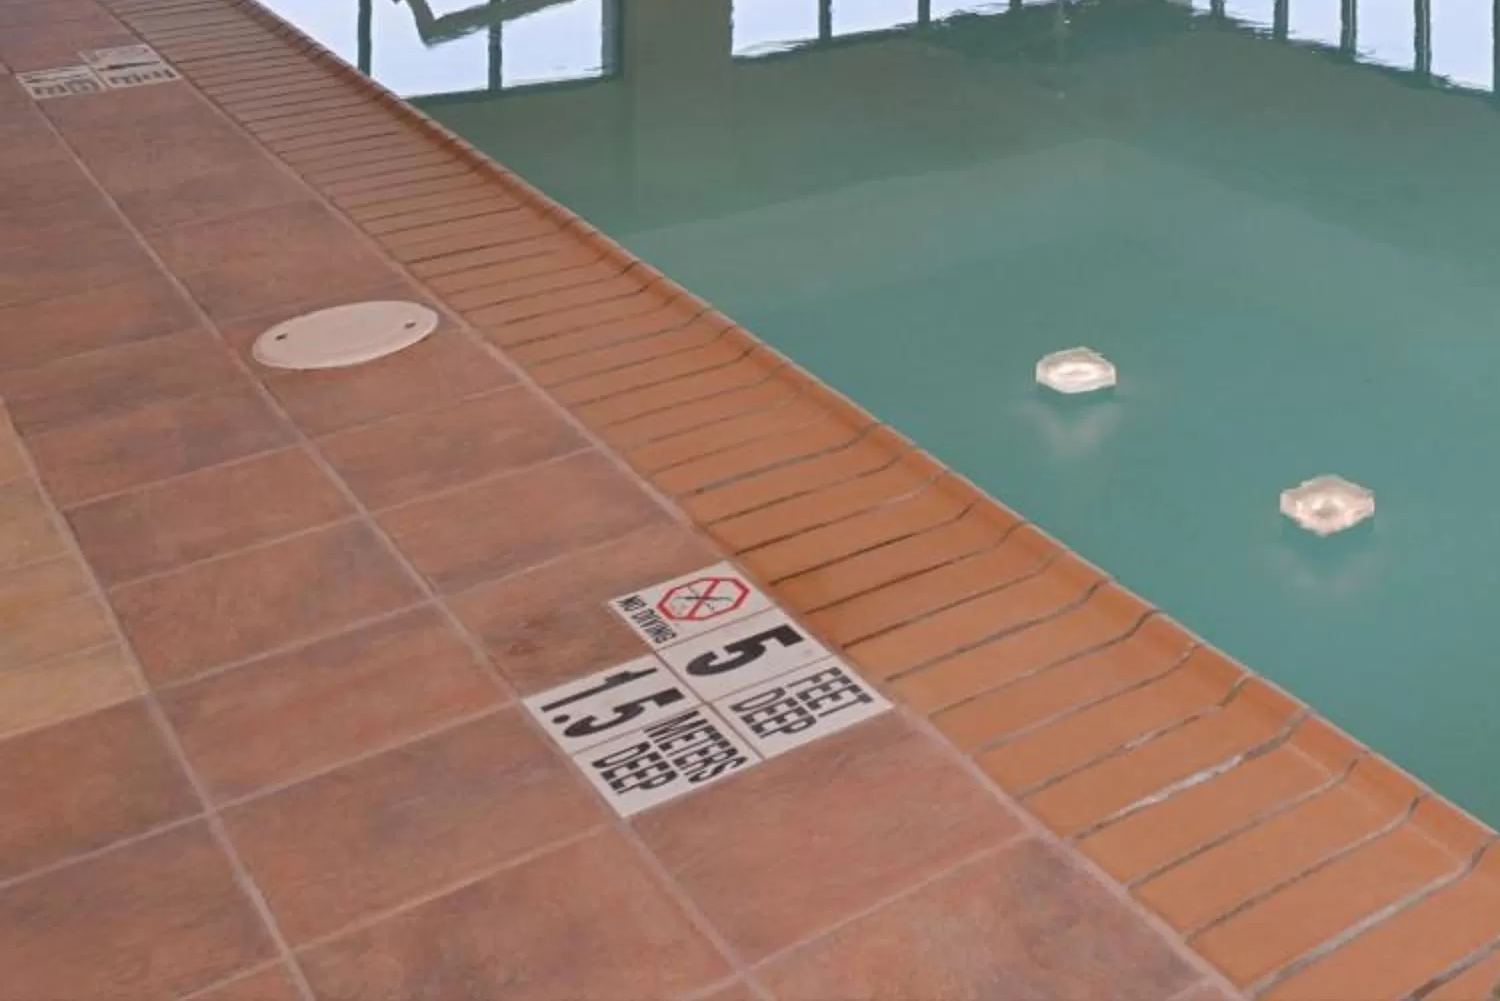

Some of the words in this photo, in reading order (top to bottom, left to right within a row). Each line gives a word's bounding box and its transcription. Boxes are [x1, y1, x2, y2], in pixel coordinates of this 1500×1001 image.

[686, 624, 805, 676] 5
[541, 667, 685, 738] 1.5
[728, 686, 818, 739] DEEP
[788, 666, 874, 717] FEET
[592, 740, 680, 795] DEEP
[643, 710, 749, 784] METERS
